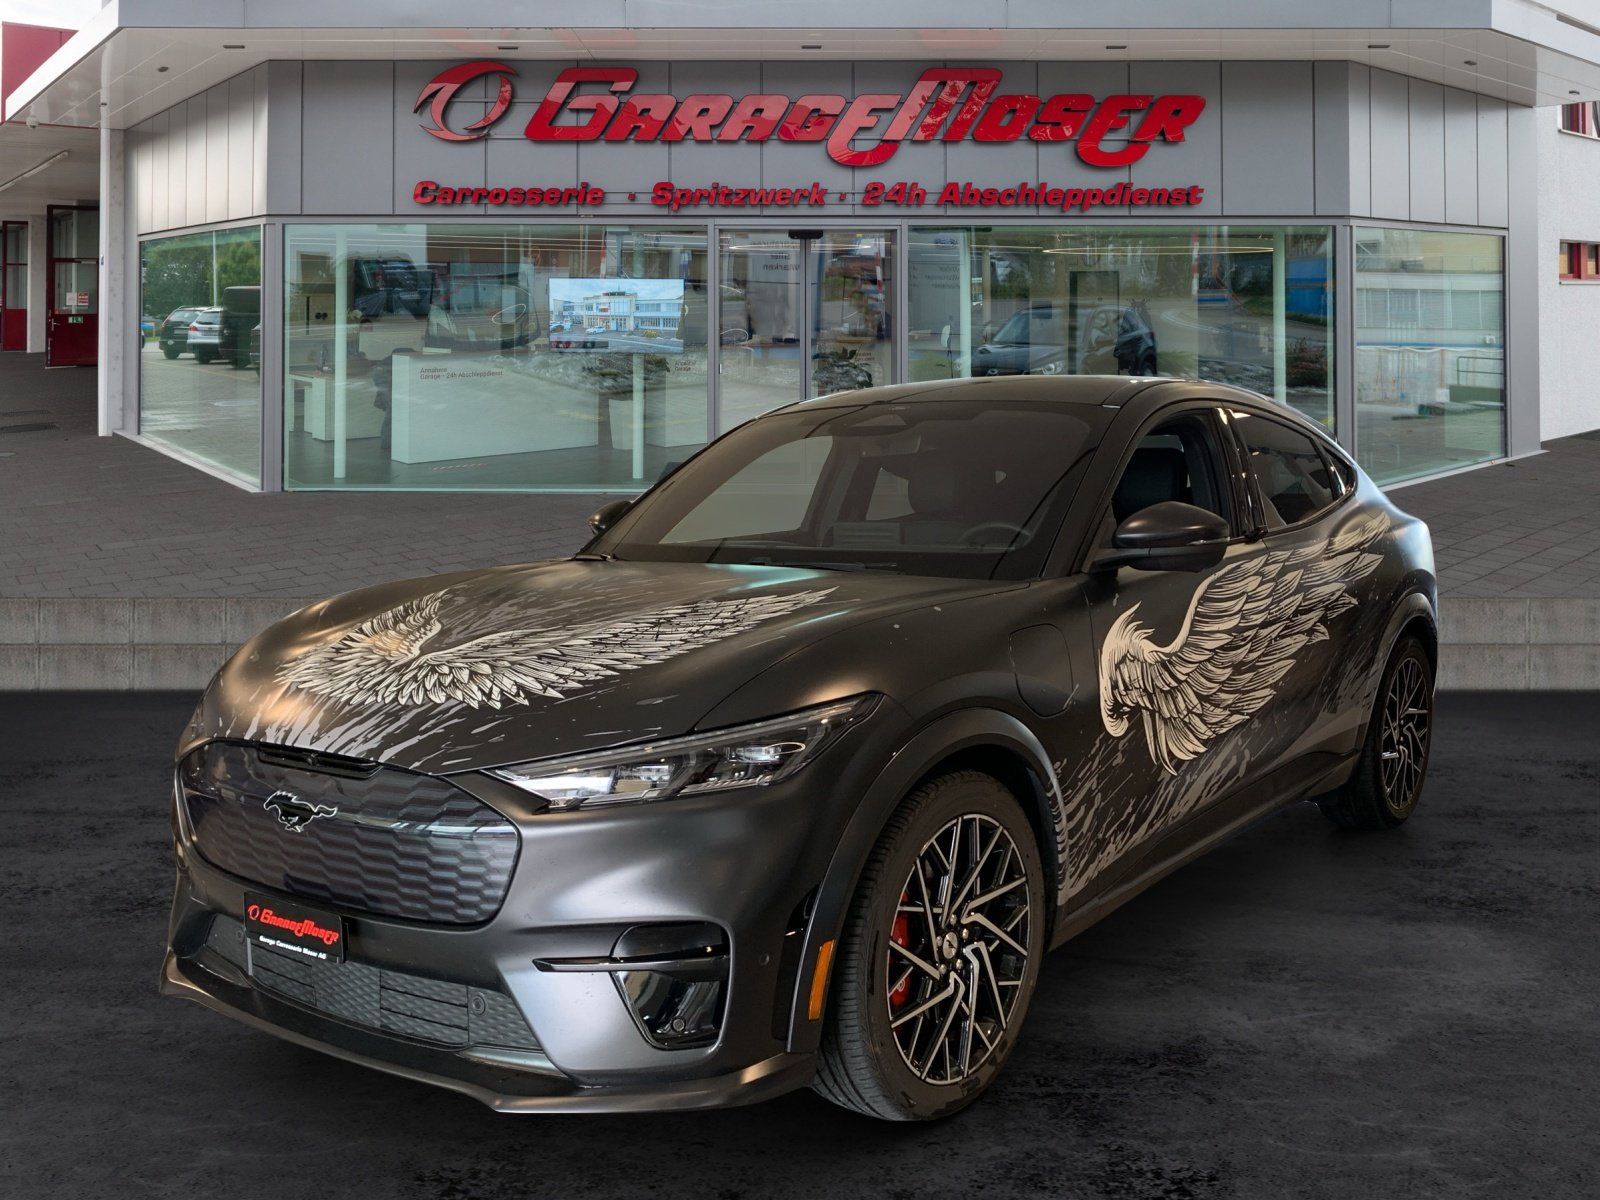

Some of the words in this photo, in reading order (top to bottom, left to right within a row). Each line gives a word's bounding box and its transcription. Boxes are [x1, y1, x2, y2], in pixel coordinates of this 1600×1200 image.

[413, 180, 605, 205] Carrosserie
[651, 181, 826, 211] Spritzwerk
[862, 181, 927, 206] 24h
[937, 181, 1204, 211] Abschleppdienst
[420, 373, 441, 381] Garage
[458, 370, 503, 378] Abschleppdienst
